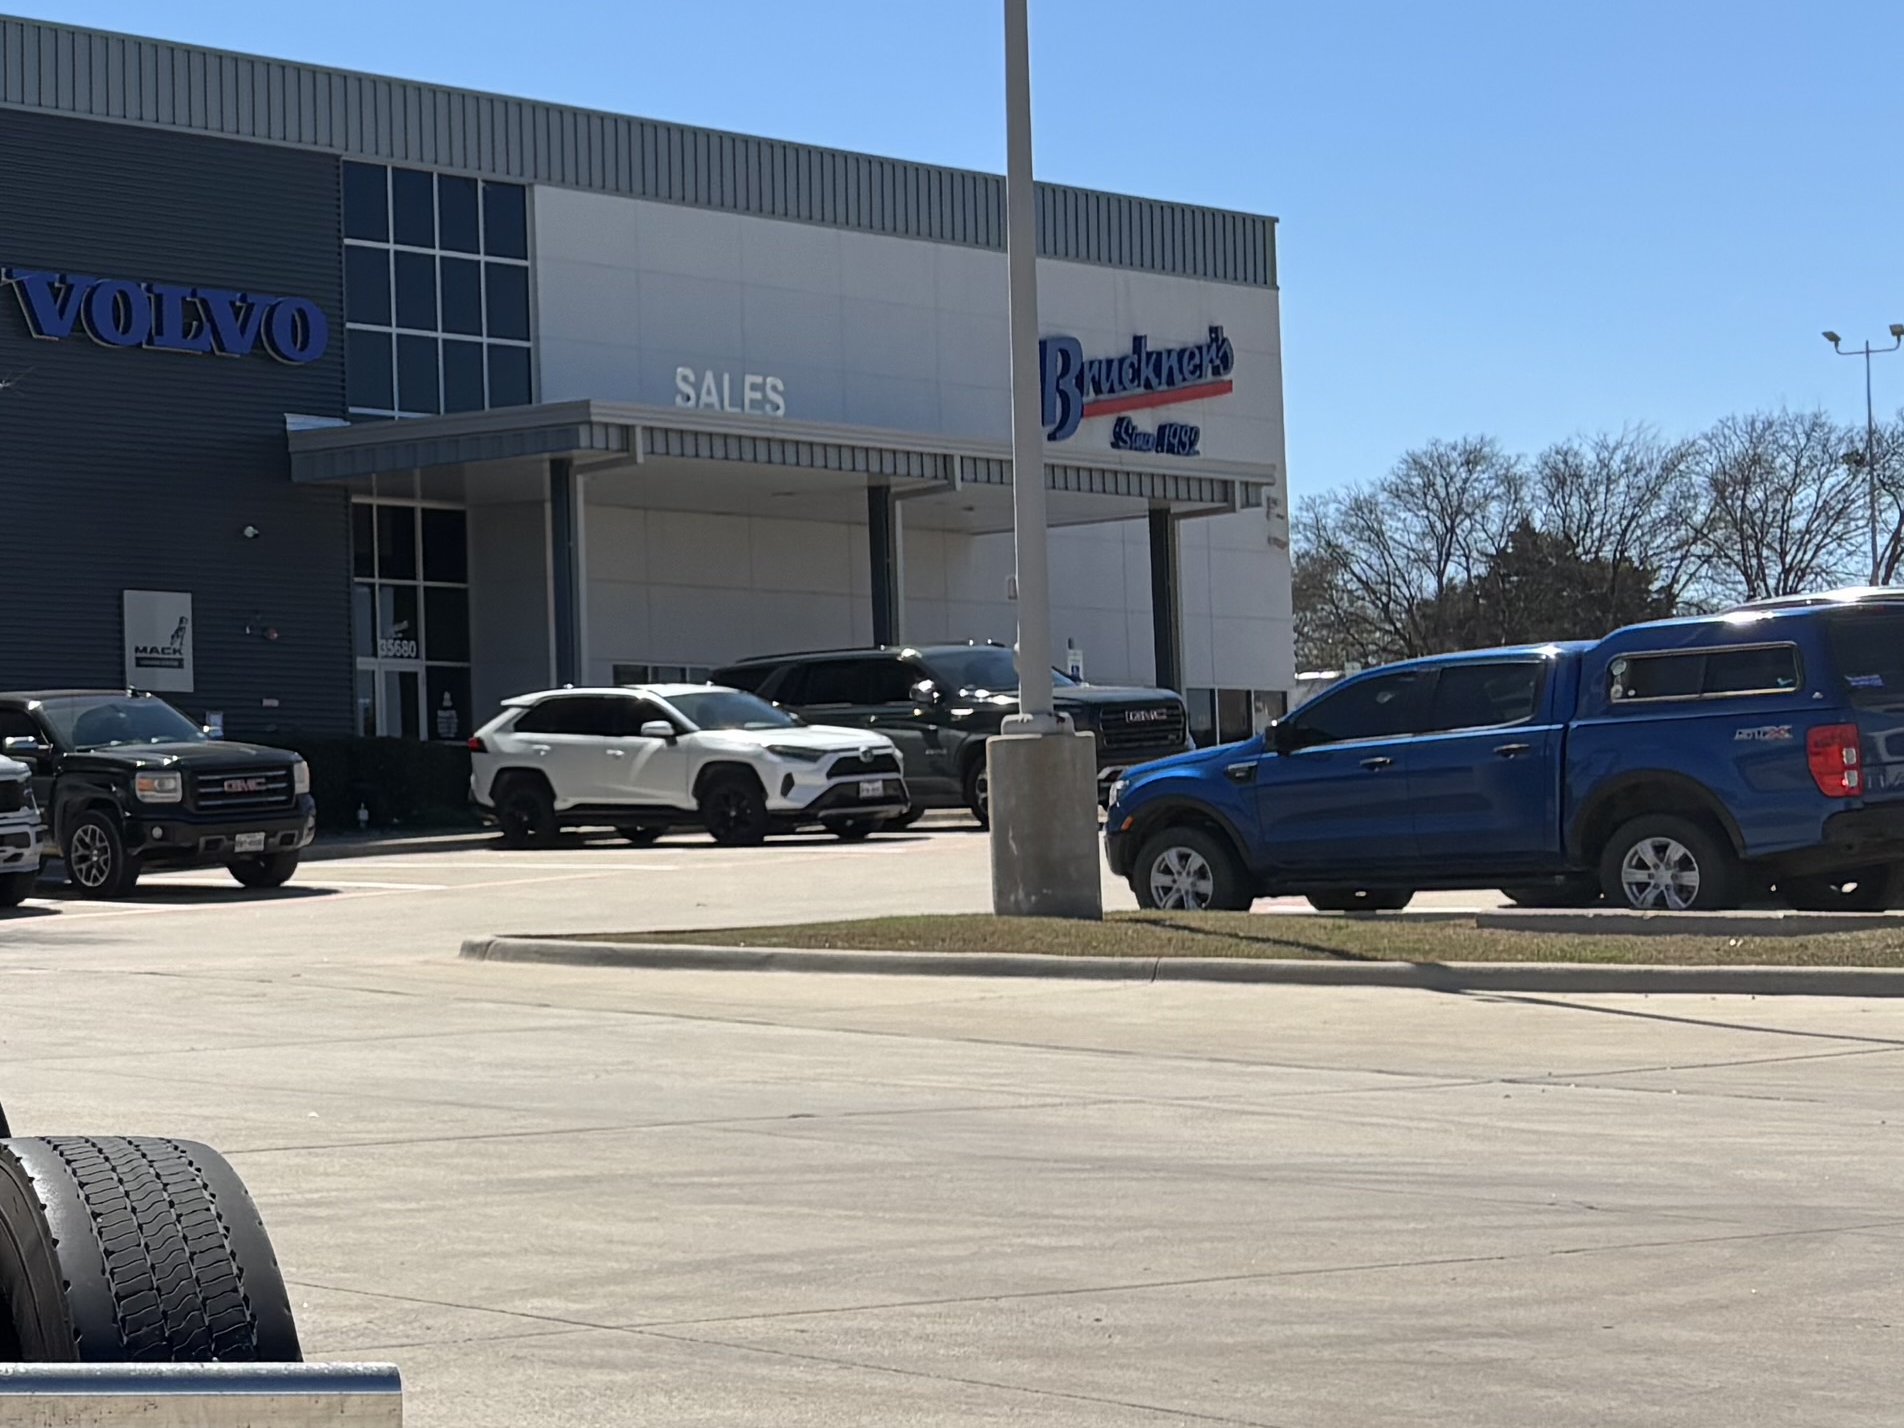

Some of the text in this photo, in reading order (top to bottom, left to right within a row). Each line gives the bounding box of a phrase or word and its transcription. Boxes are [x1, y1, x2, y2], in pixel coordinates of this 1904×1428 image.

[1, 268, 329, 365] VOLVO
[675, 366, 785, 417] SALES
[1039, 325, 1235, 442] Bruckner's
[135, 646, 183, 655] MACK
[379, 639, 417, 658] 35680
[224, 778, 266, 792] GMC
